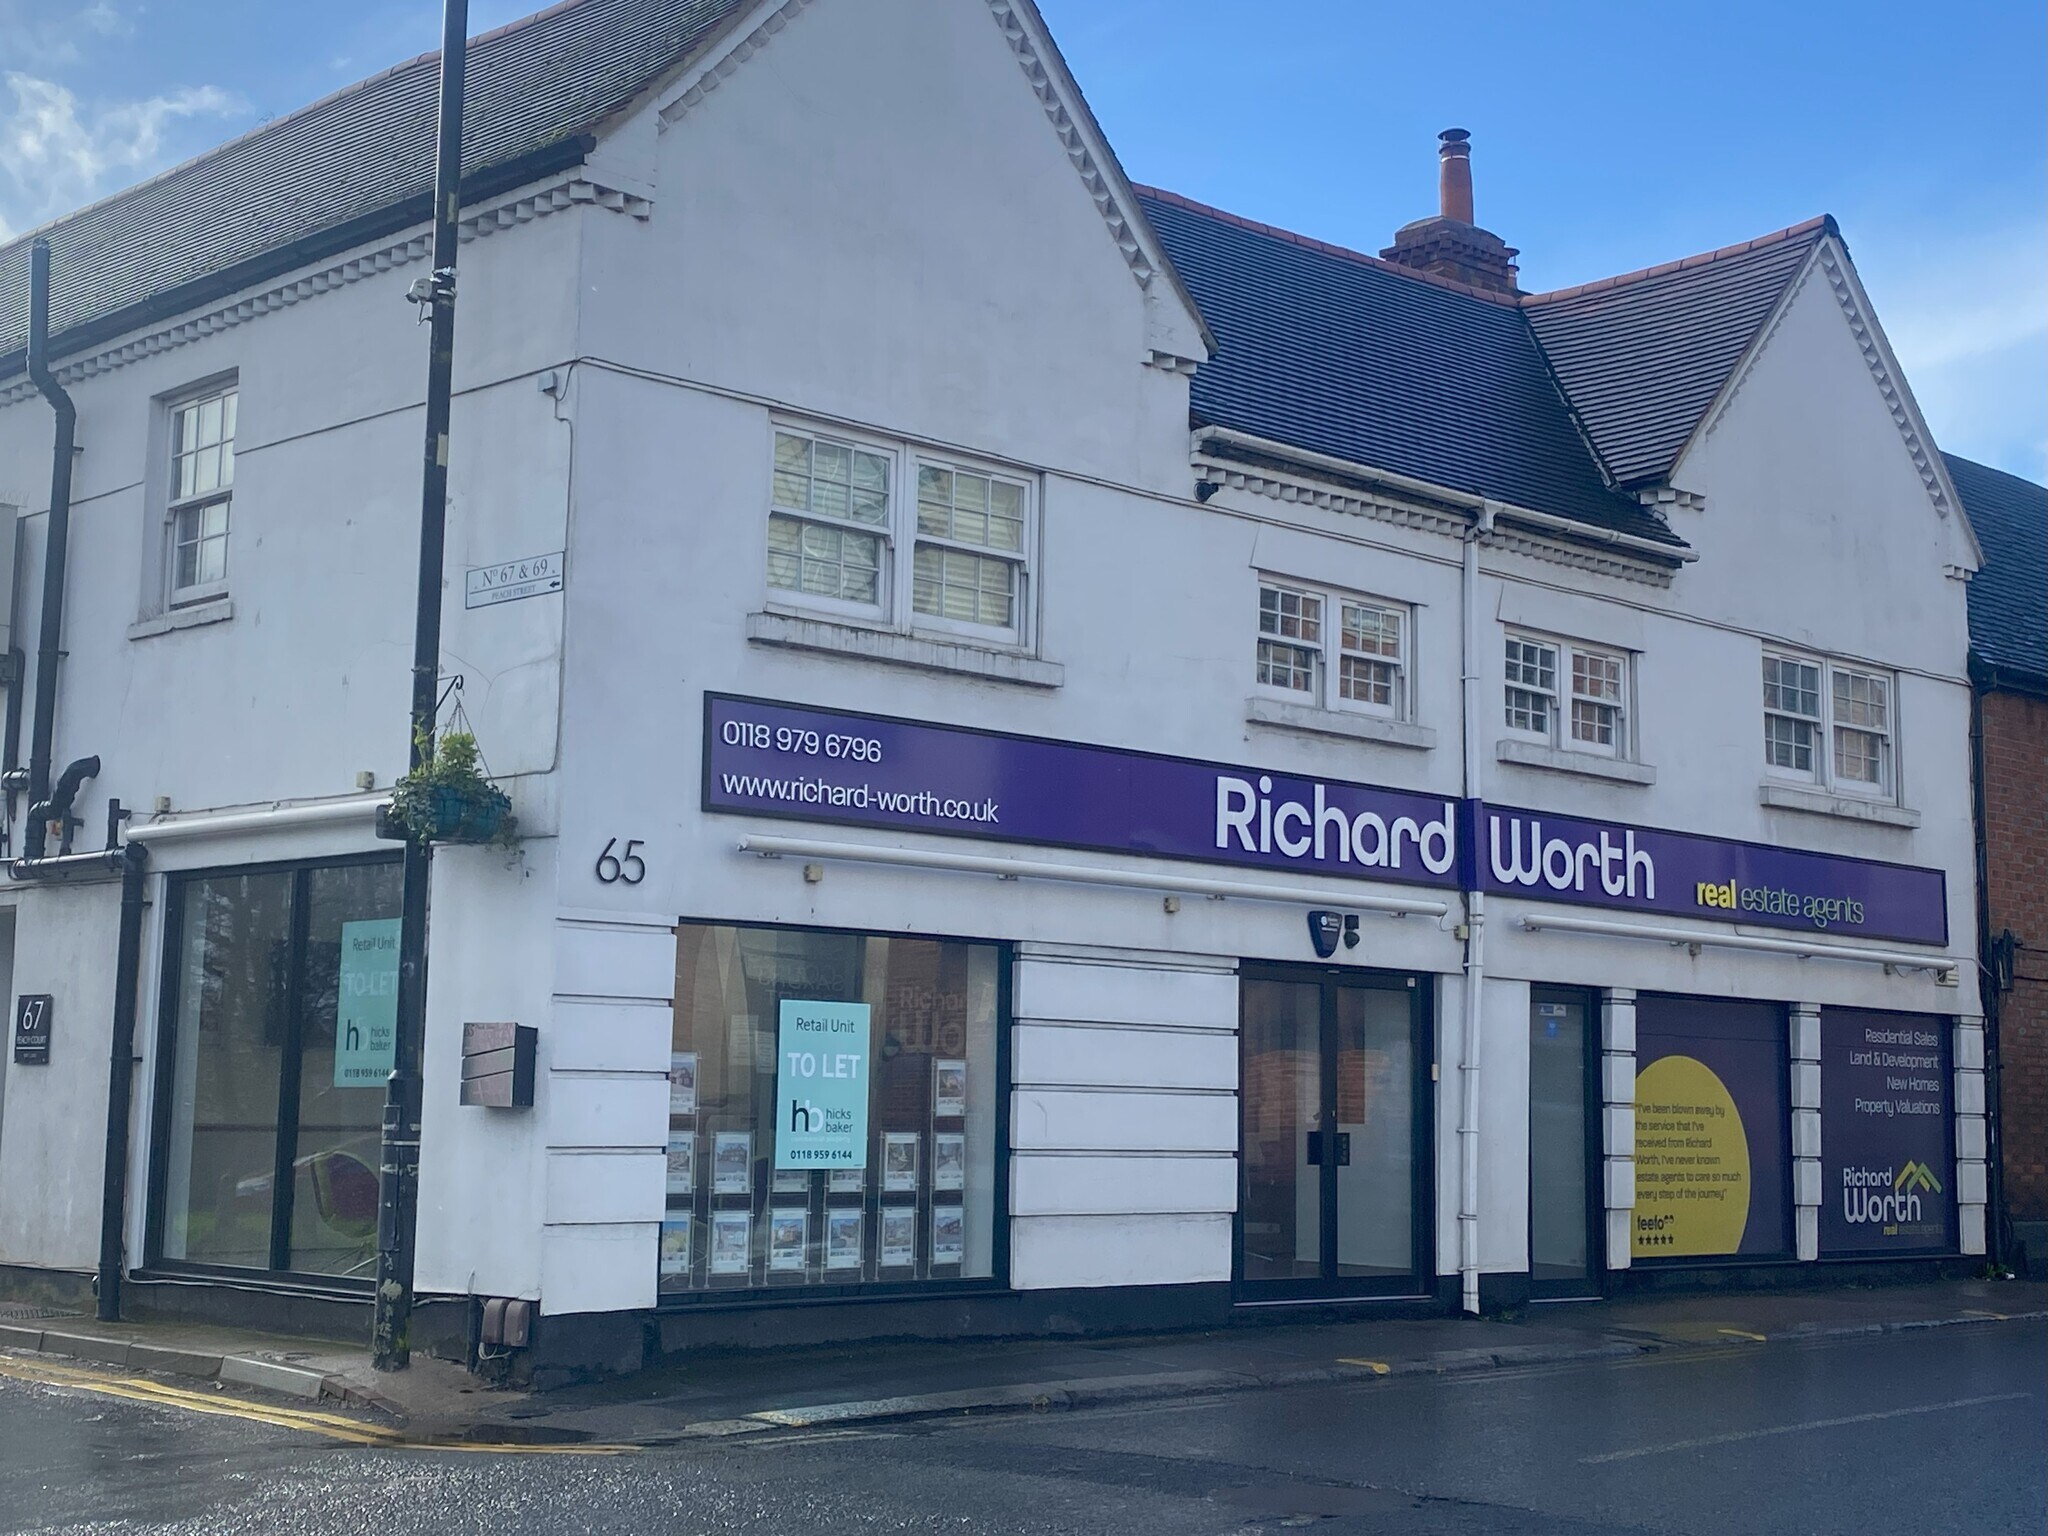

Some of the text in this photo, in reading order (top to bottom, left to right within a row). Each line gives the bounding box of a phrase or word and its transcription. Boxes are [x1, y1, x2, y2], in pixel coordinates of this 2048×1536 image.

[500, 565, 515, 583] 67
[519, 564, 529, 580] &
[533, 558, 548, 577] 69
[723, 720, 882, 763] 0118 979 6796
[723, 773, 999, 823] www.richard-worth.co.uk
[1215, 775, 1655, 900] Richard Worth
[596, 837, 646, 885] 65
[1697, 879, 1865, 928] real estate agents
[353, 936, 396, 951] Retail Unit
[344, 970, 399, 997] TO LET
[23, 1000, 44, 1030] 67
[371, 1026, 390, 1038] hicks
[796, 1017, 855, 1033] Retail Unit
[1865, 1028, 1939, 1046] Residential Sales
[370, 1040, 391, 1051] baker
[787, 1052, 816, 1078] TO
[822, 1053, 861, 1079] LET
[1850, 1050, 1939, 1071] Land & Development
[344, 1068, 359, 1078] 0118
[361, 1068, 373, 1078] 959
[1886, 1076, 1940, 1092] New Homes
[826, 1108, 851, 1120] hicks
[1652, 1103, 1671, 1115] been
[1672, 1103, 1694, 1115] blown
[1715, 1105, 1725, 1118] by
[1855, 1098, 1940, 1117] Property Valuations
[826, 1121, 853, 1133] baker
[1648, 1121, 1675, 1132] service
[1676, 1121, 1691, 1132] that
[1668, 1137, 1684, 1148] from
[1685, 1137, 1712, 1148] Richard
[790, 1150, 852, 1160] 0118 959 6144
[1696, 1155, 1721, 1166] known
[1636, 1172, 1659, 1182] estate
[1661, 1172, 1685, 1185] agents
[1686, 1172, 1694, 1182] to
[1712, 1172, 1721, 1182] so
[1721, 1171, 1742, 1182] much
[1843, 1166, 1892, 1187] Richard
[1637, 1190, 1657, 1202] every
[1659, 1189, 1675, 1202] step
[1676, 1188, 1684, 1199] of
[1684, 1189, 1698, 1199] the
[1844, 1187, 1921, 1223] Worth
